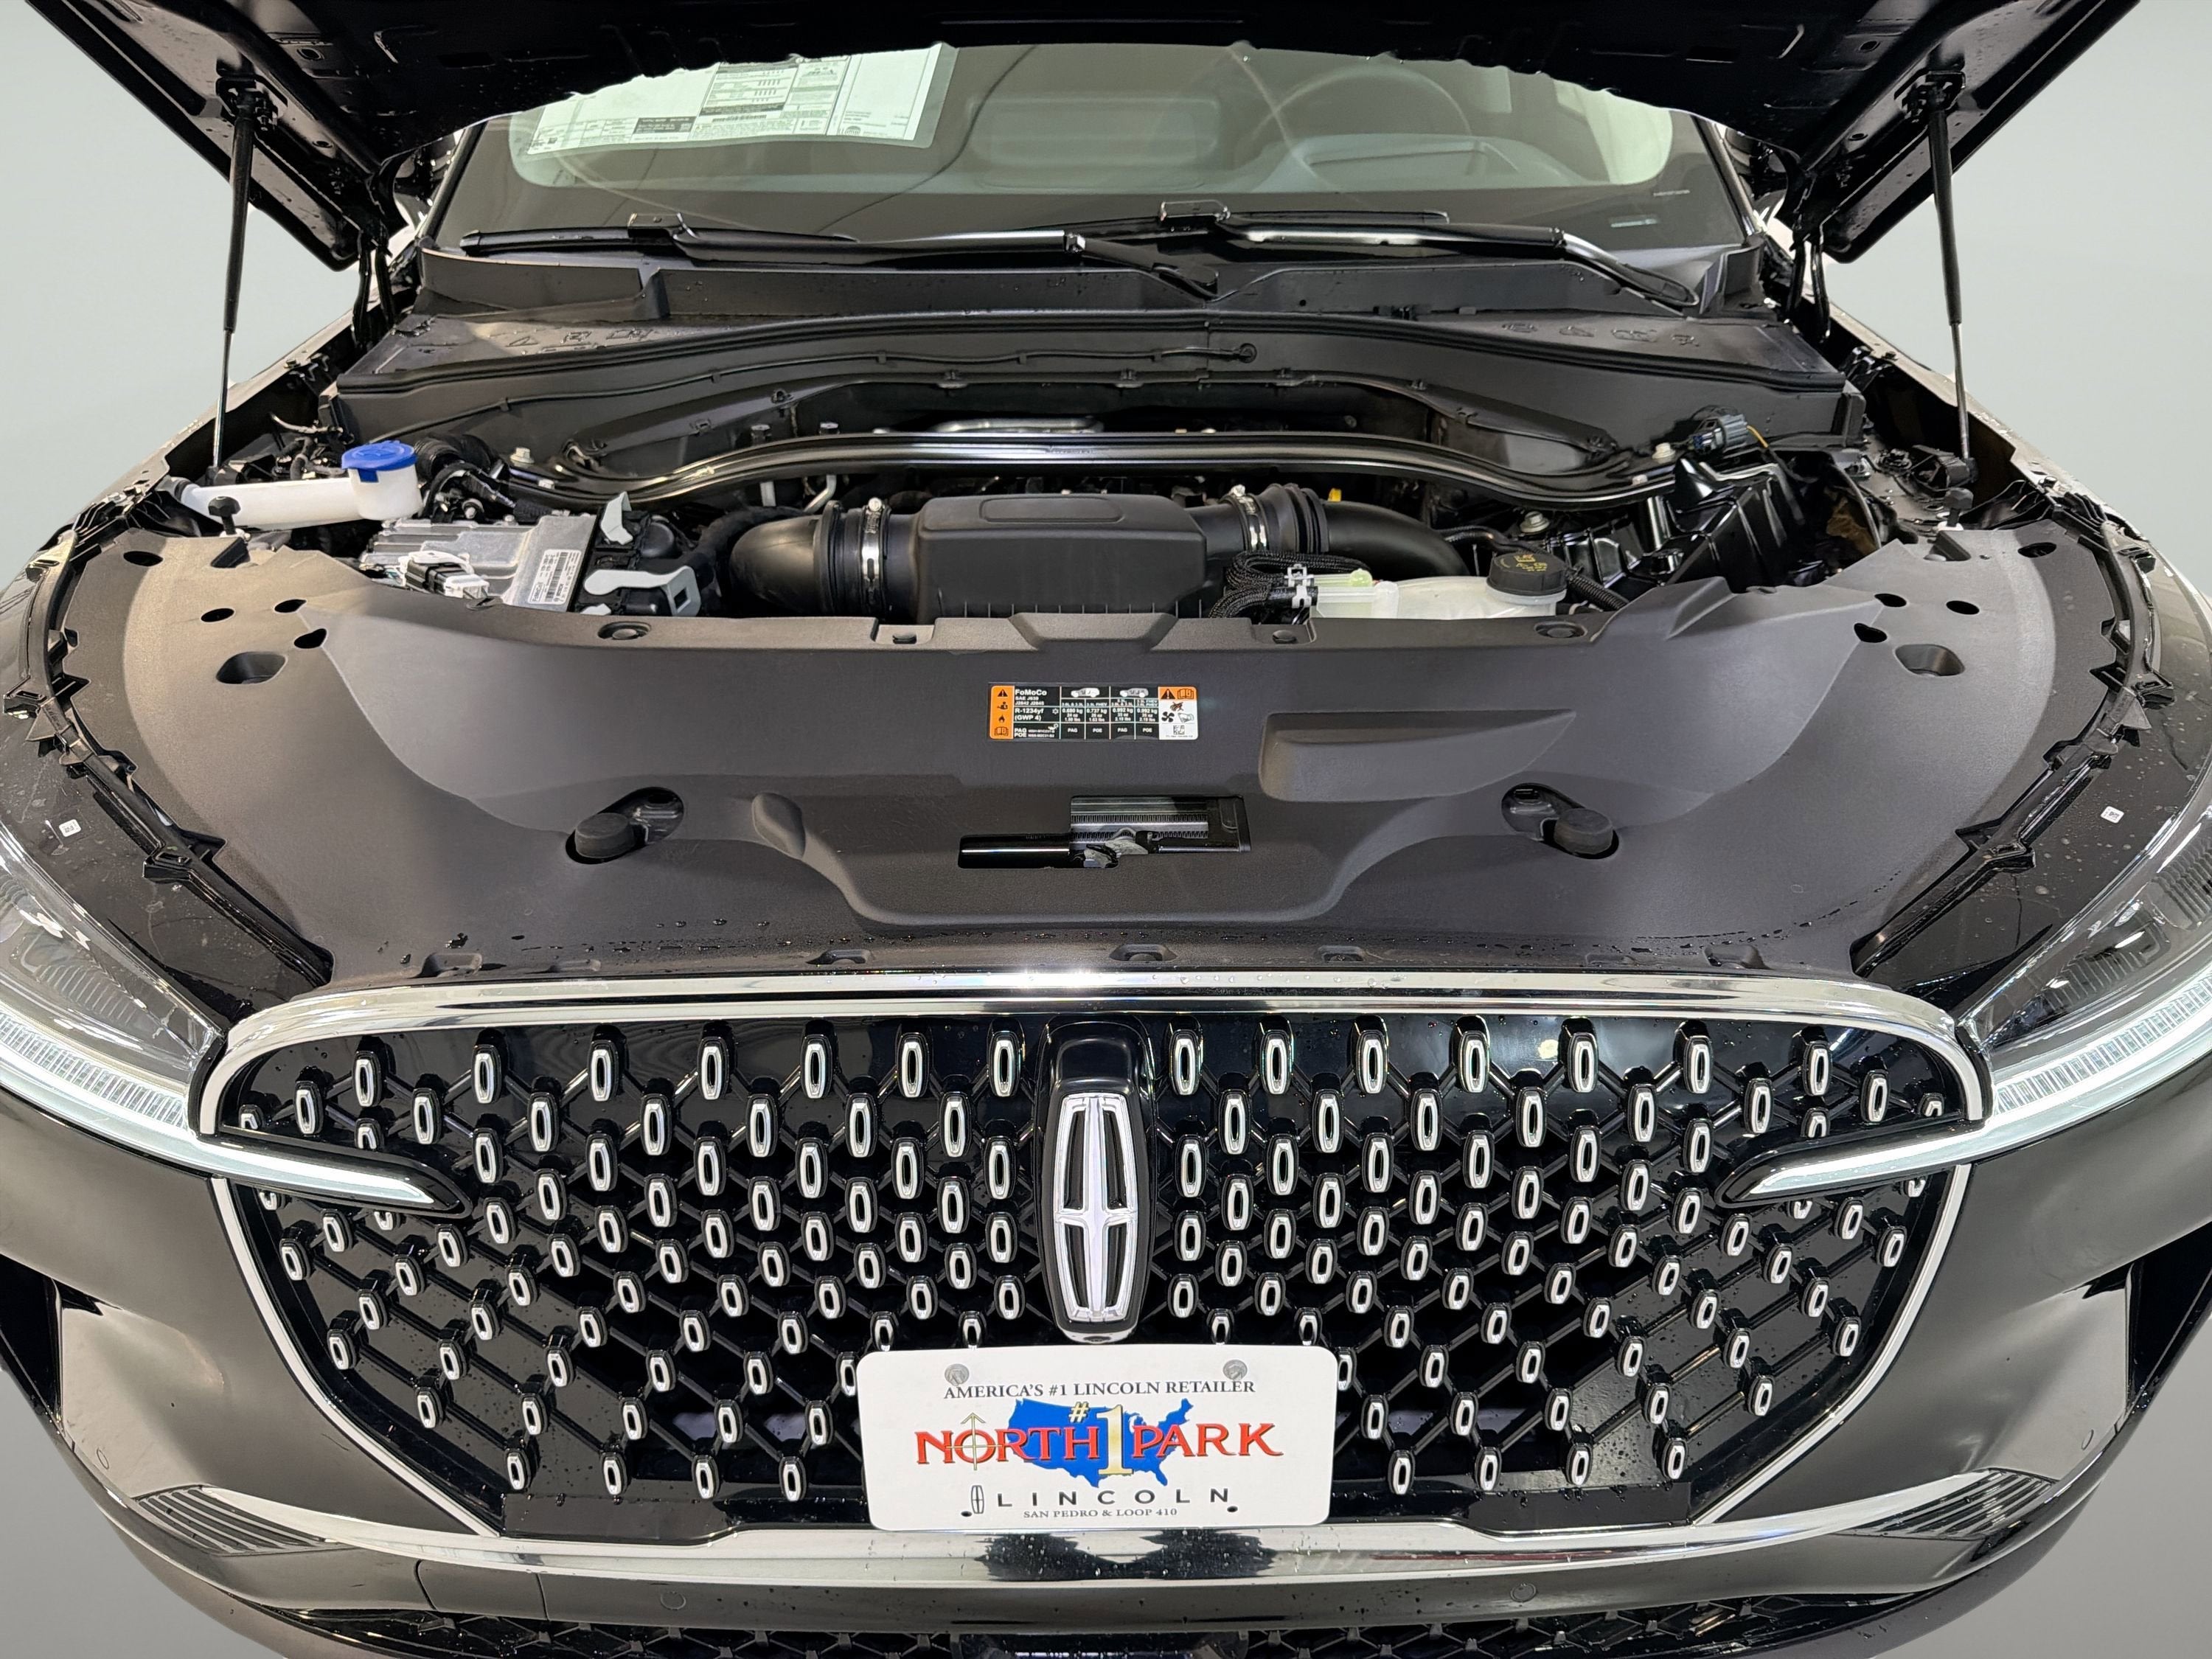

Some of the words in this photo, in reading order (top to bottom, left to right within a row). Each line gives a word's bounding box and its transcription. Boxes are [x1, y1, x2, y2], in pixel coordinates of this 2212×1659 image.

[944, 1383, 1043, 1399] AMERICA'S
[1048, 1384, 1068, 1397] #1
[1074, 1382, 1161, 1396] LINCOLN
[1165, 1380, 1256, 1394] RETAILER
[914, 1426, 1100, 1465] NORTH
[1132, 1422, 1284, 1458] PARK
[998, 1488, 1228, 1507] LINCOLN
[1023, 1510, 1049, 1518] SAN
[1054, 1509, 1099, 1517] PEDRO
[1102, 1509, 1112, 1517] &
[1116, 1509, 1152, 1517] LOOP
[1155, 1508, 1178, 1516] 410
